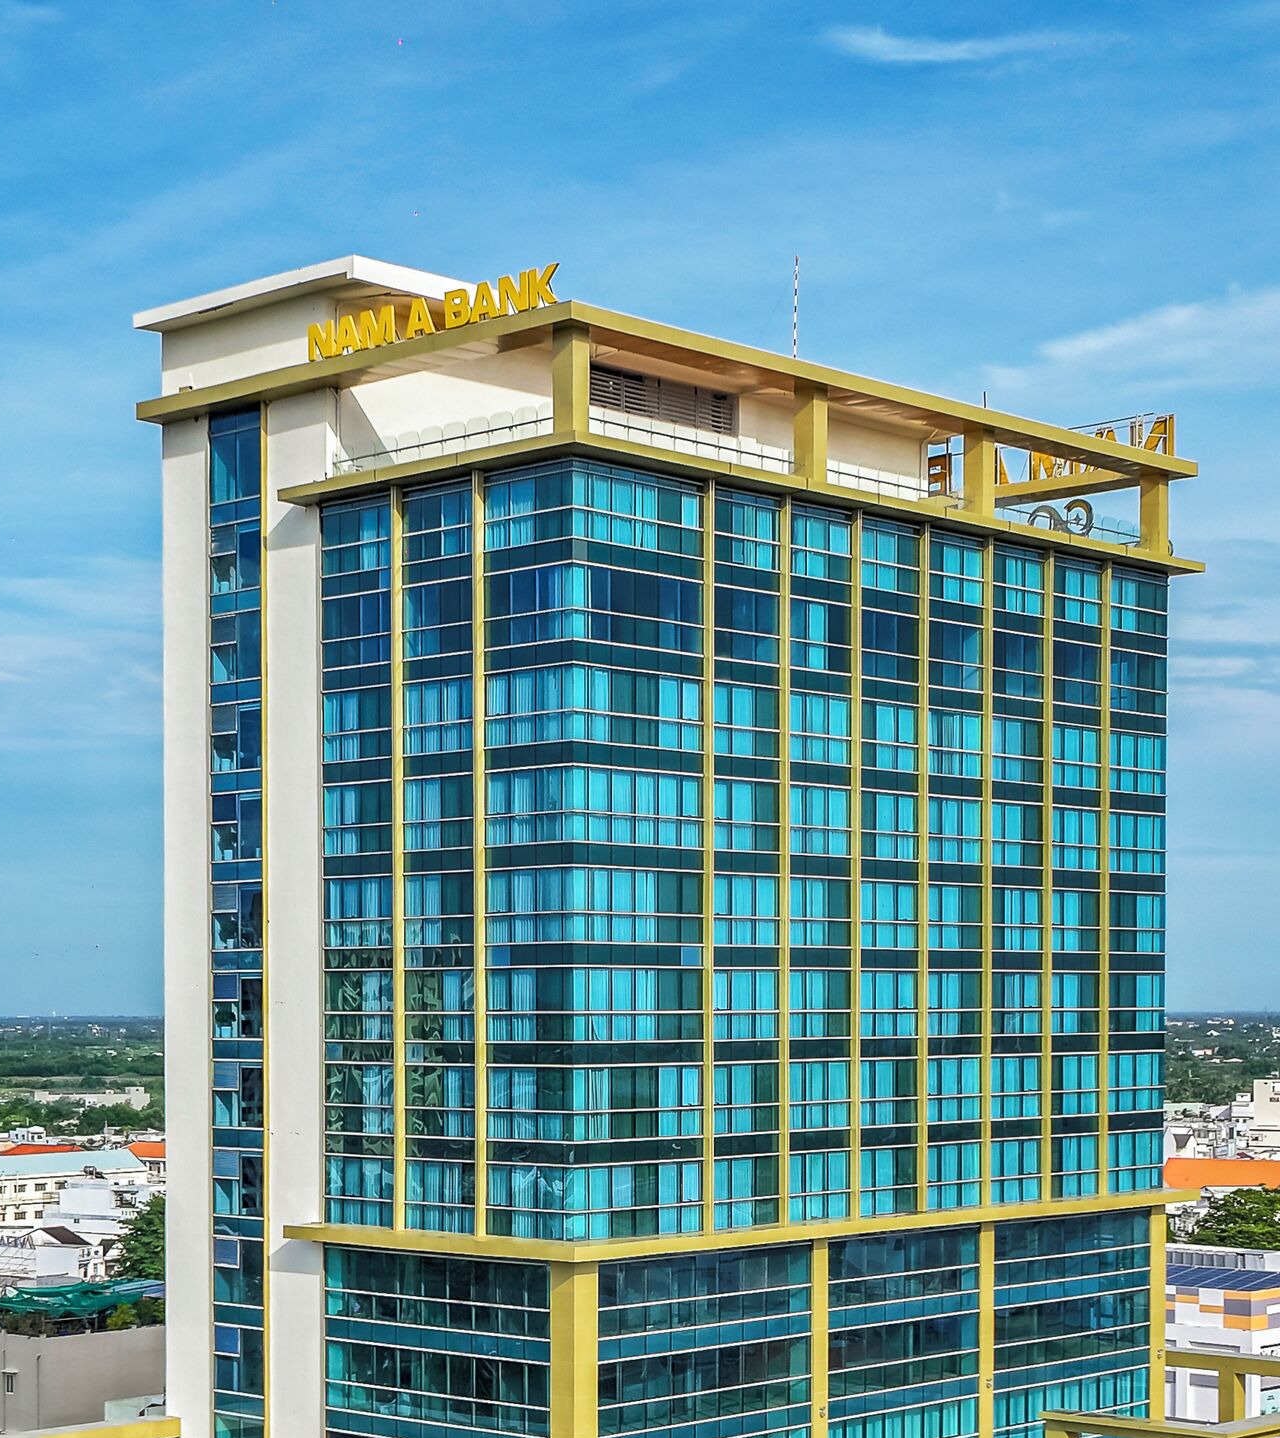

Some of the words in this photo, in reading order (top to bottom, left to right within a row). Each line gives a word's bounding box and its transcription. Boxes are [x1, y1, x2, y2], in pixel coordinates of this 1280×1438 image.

[307, 304, 398, 362] NAM
[406, 297, 436, 340] A
[444, 262, 560, 330] BANK
